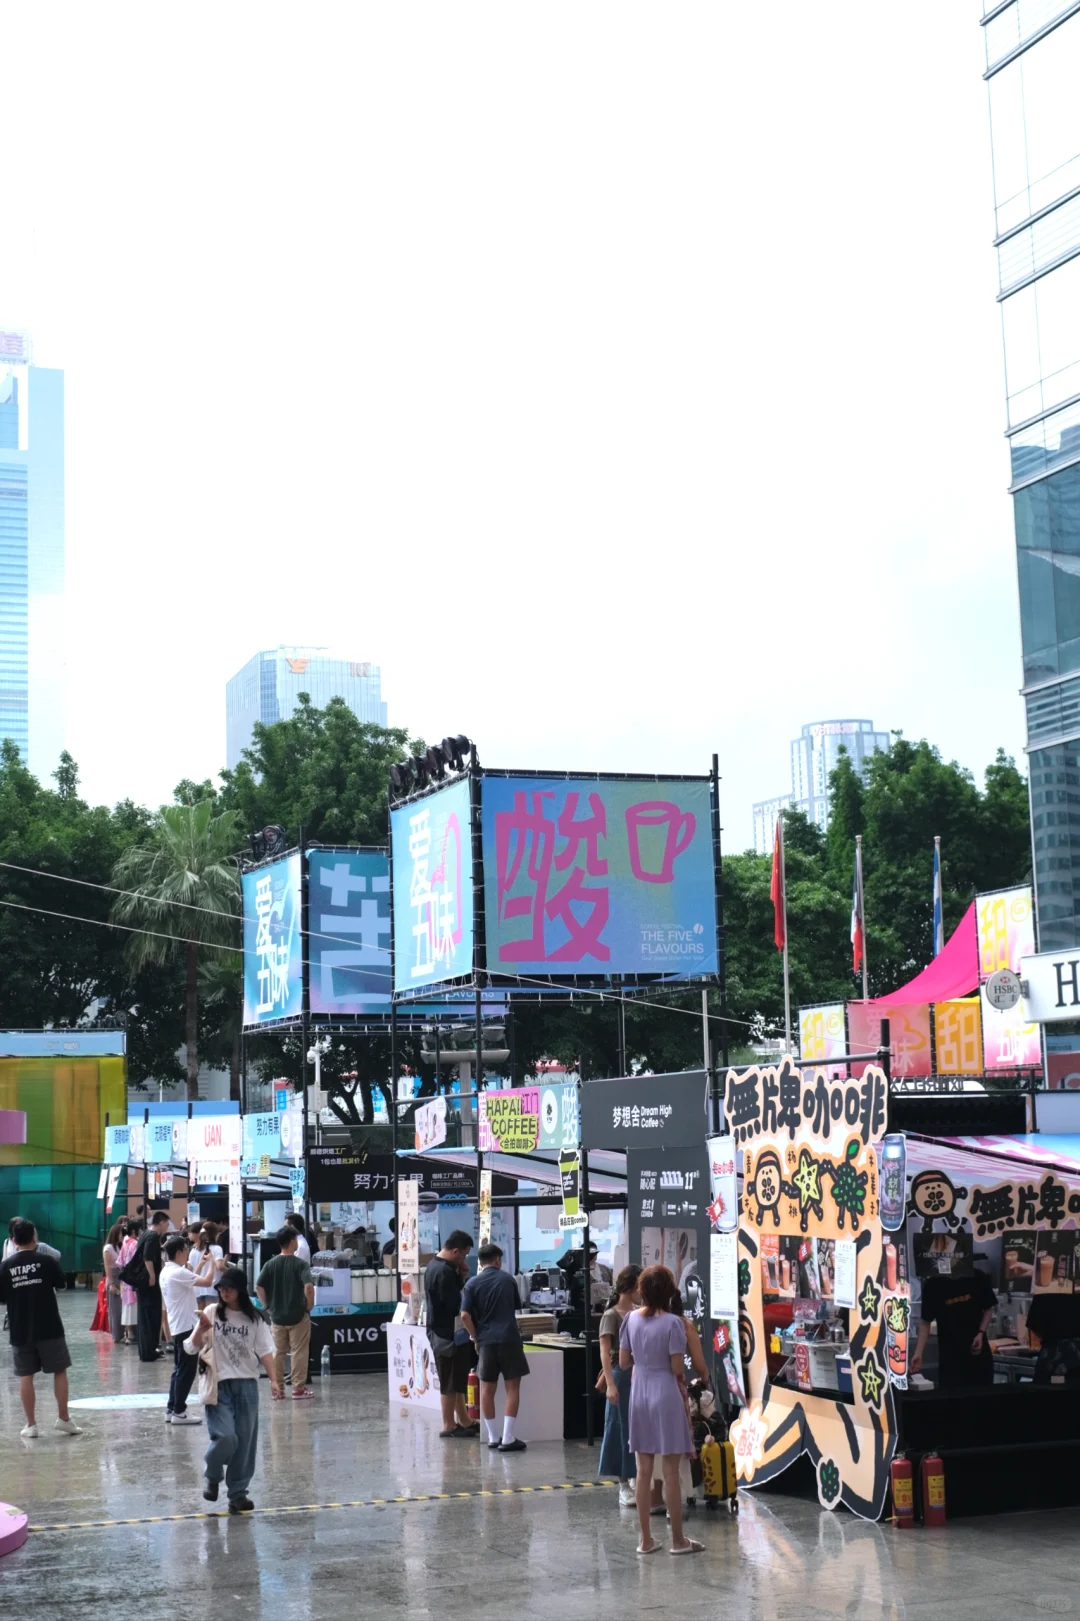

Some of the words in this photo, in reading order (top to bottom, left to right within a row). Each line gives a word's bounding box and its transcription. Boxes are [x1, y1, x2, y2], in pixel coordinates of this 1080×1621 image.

[409, 808, 432, 899] 爱
[496, 791, 611, 962] 酸
[410, 879, 456, 978] 五味
[640, 931, 664, 941] THE
[668, 931, 693, 941] FIVE
[980, 898, 1009, 974] 甜
[641, 943, 704, 954] FLAVOURS
[994, 985, 1018, 995] HSBC
[938, 1006, 979, 1071] 甜
[486, 1098, 521, 1116] HAPA!
[641, 1106, 658, 1116] Dream
[659, 1104, 672, 1118] High
[727, 1061, 885, 1145] 無牌咖啡
[491, 1116, 537, 1136] COFFEE
[641, 1117, 658, 1128] Coffee
[969, 1175, 1080, 1237] 無牌
[11, 1275, 28, 1283] VISUAL
[214, 1322, 249, 1336] Mardi
